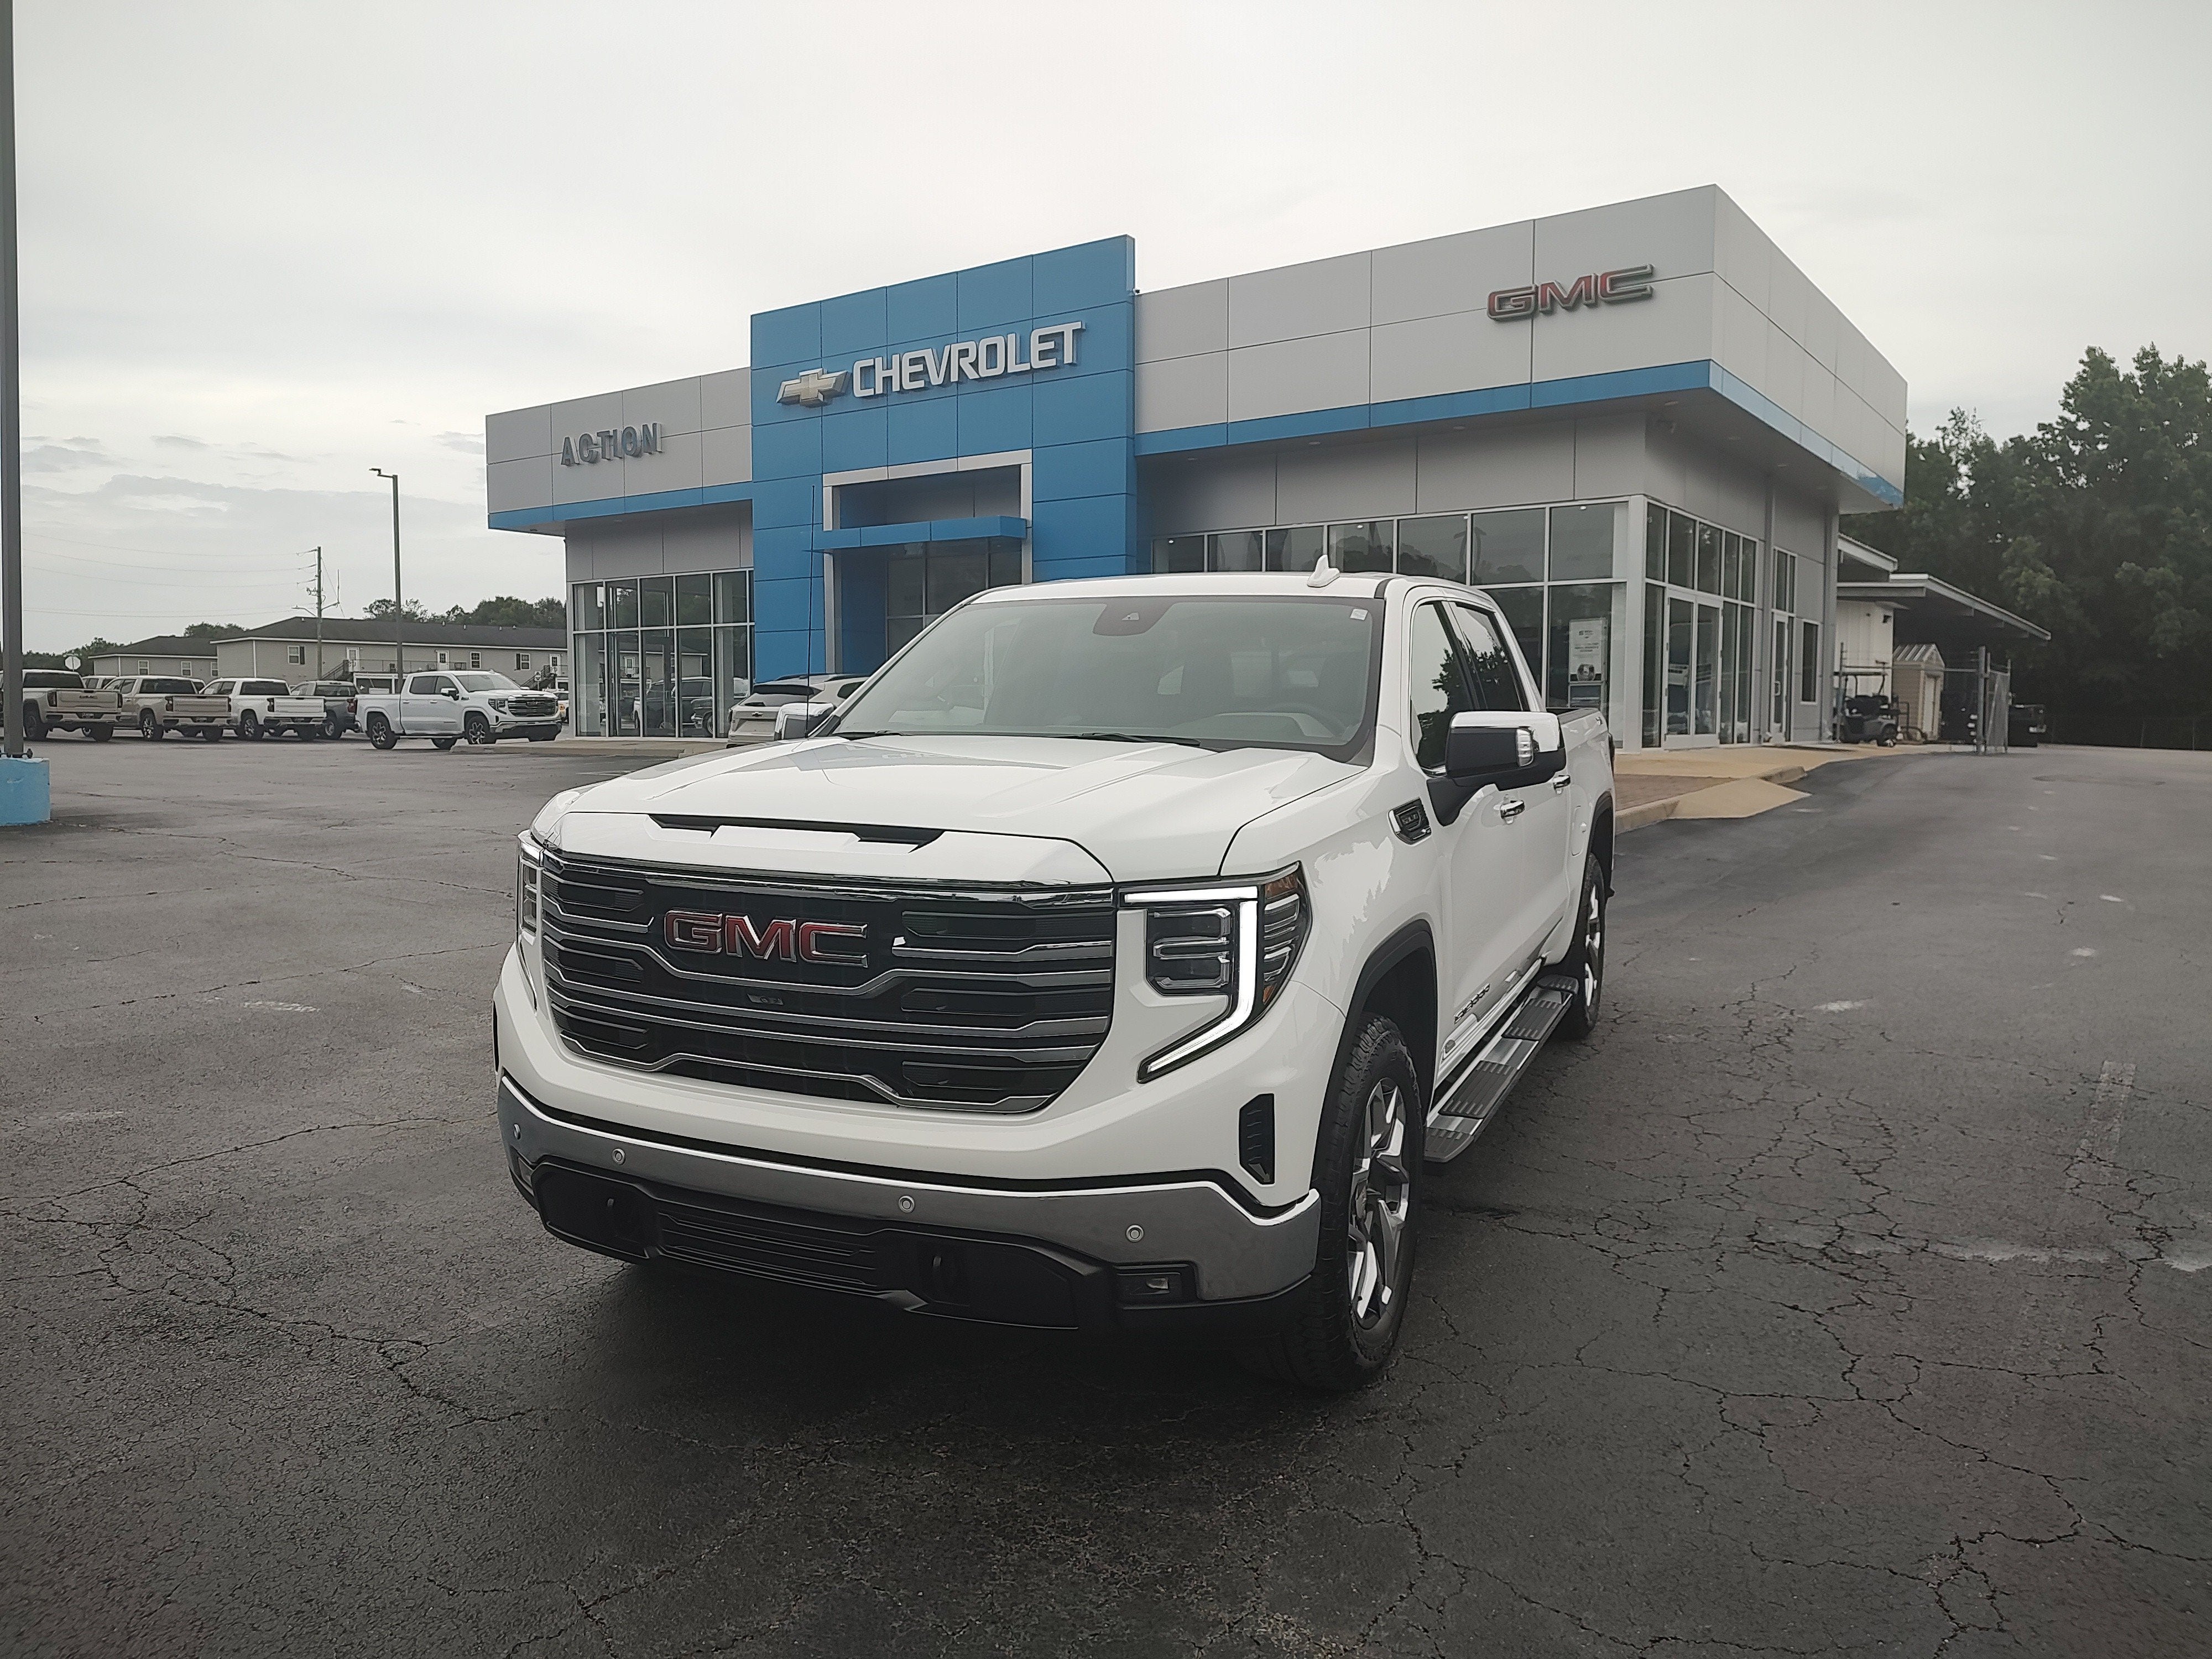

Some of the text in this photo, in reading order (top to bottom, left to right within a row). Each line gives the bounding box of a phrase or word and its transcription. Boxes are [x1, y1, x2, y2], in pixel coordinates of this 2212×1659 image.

[1487, 264, 1653, 321] GMC
[852, 321, 1086, 398] CHEVROLET
[561, 422, 662, 466] ACTION
[664, 910, 868, 968] GMC
